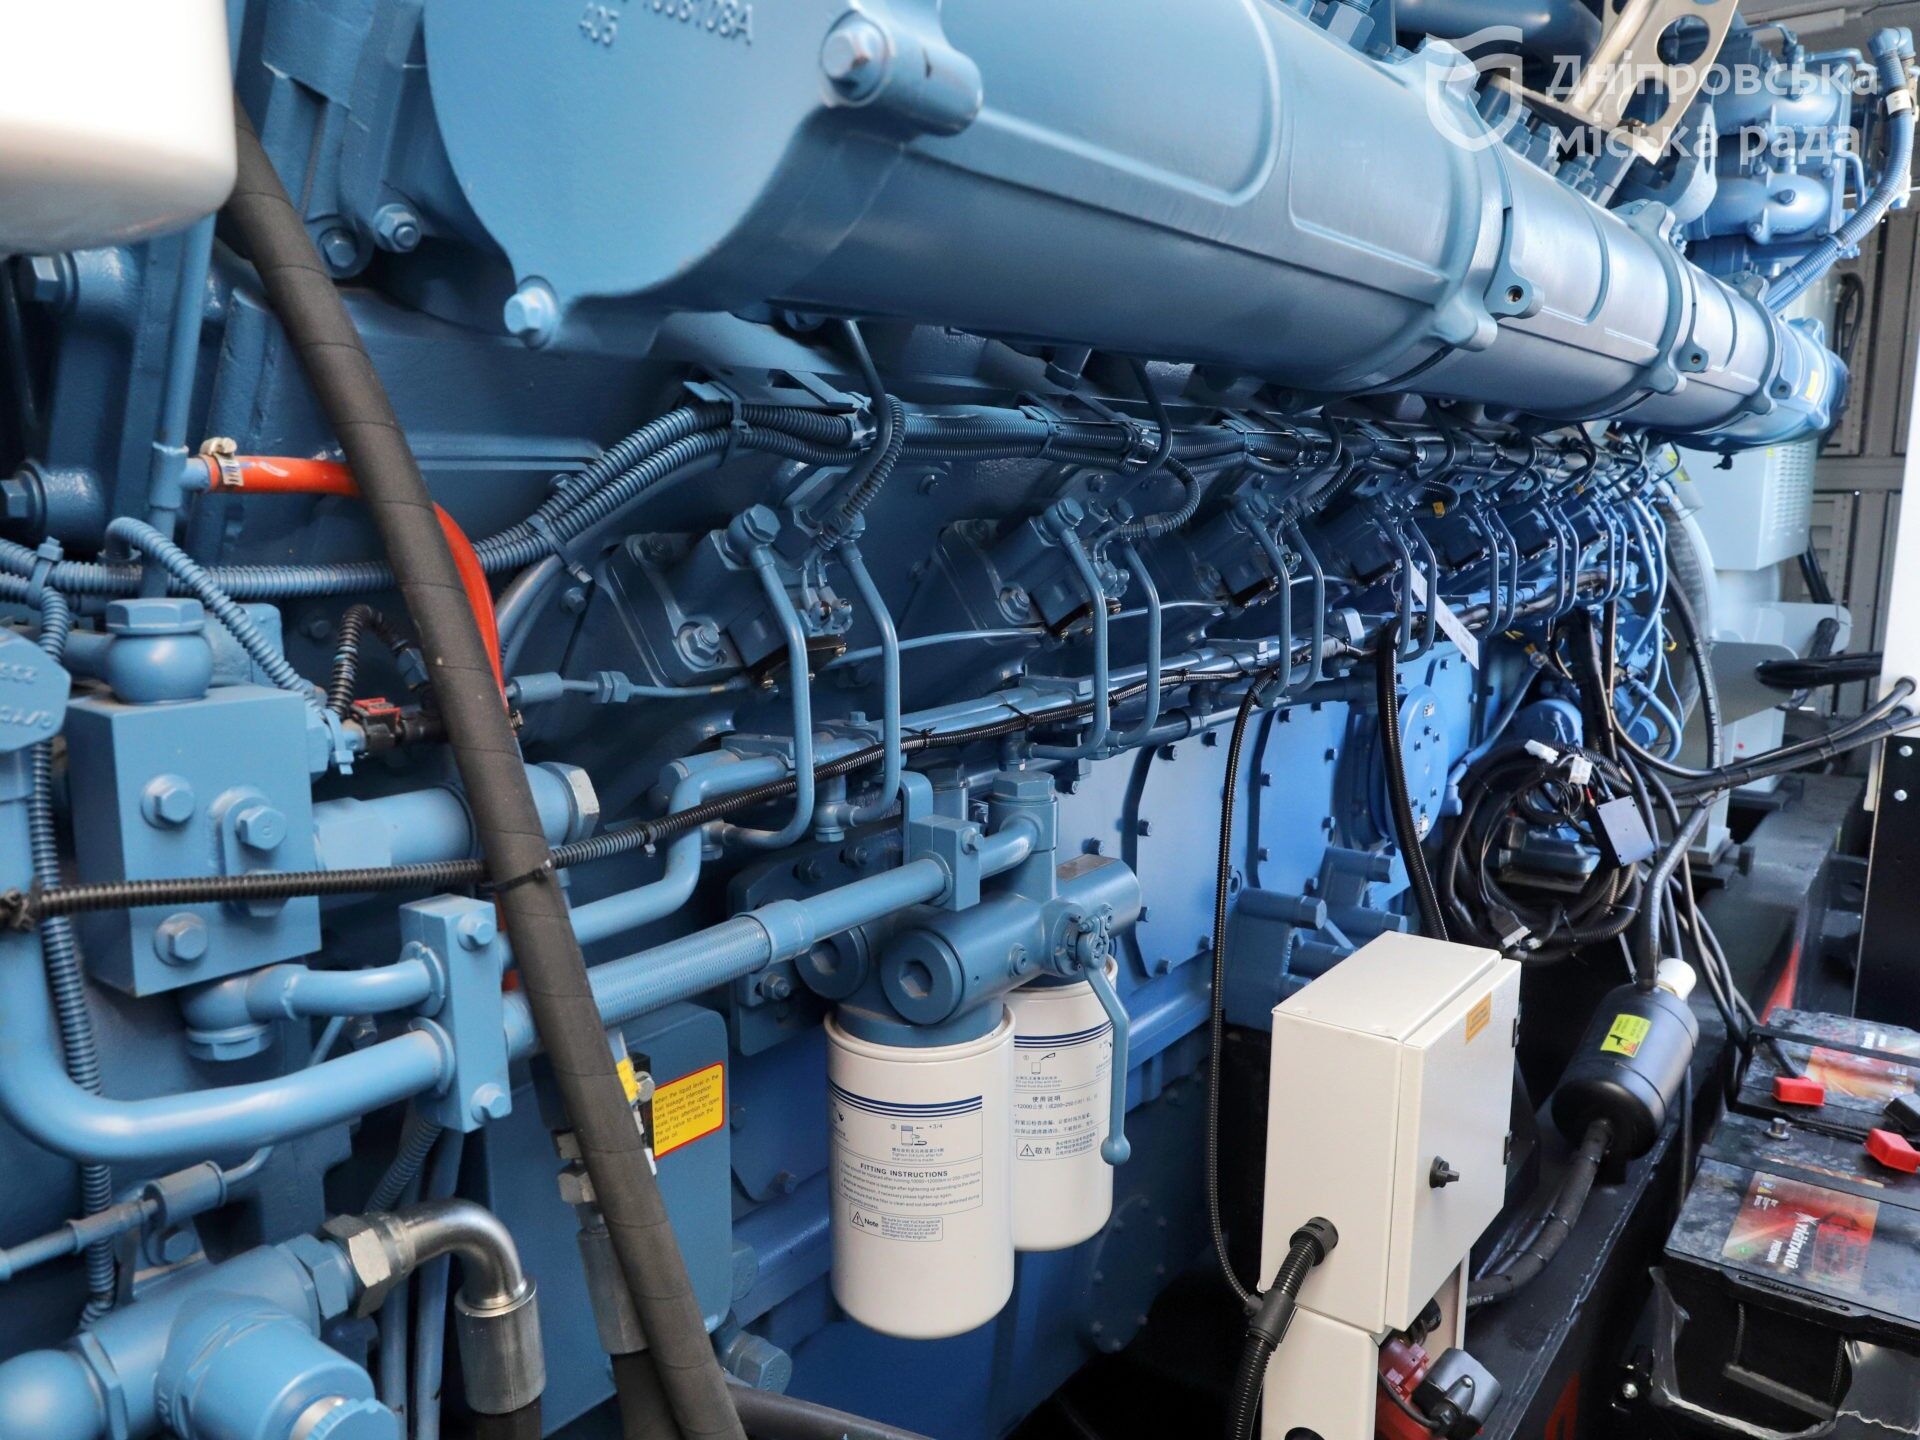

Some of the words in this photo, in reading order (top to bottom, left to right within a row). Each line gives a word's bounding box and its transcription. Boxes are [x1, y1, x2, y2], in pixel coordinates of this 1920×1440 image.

[861, 1163, 887, 1175] FITTING
[890, 1170, 948, 1178] INSTRUCTIONS
[865, 1218, 879, 1227] Note
